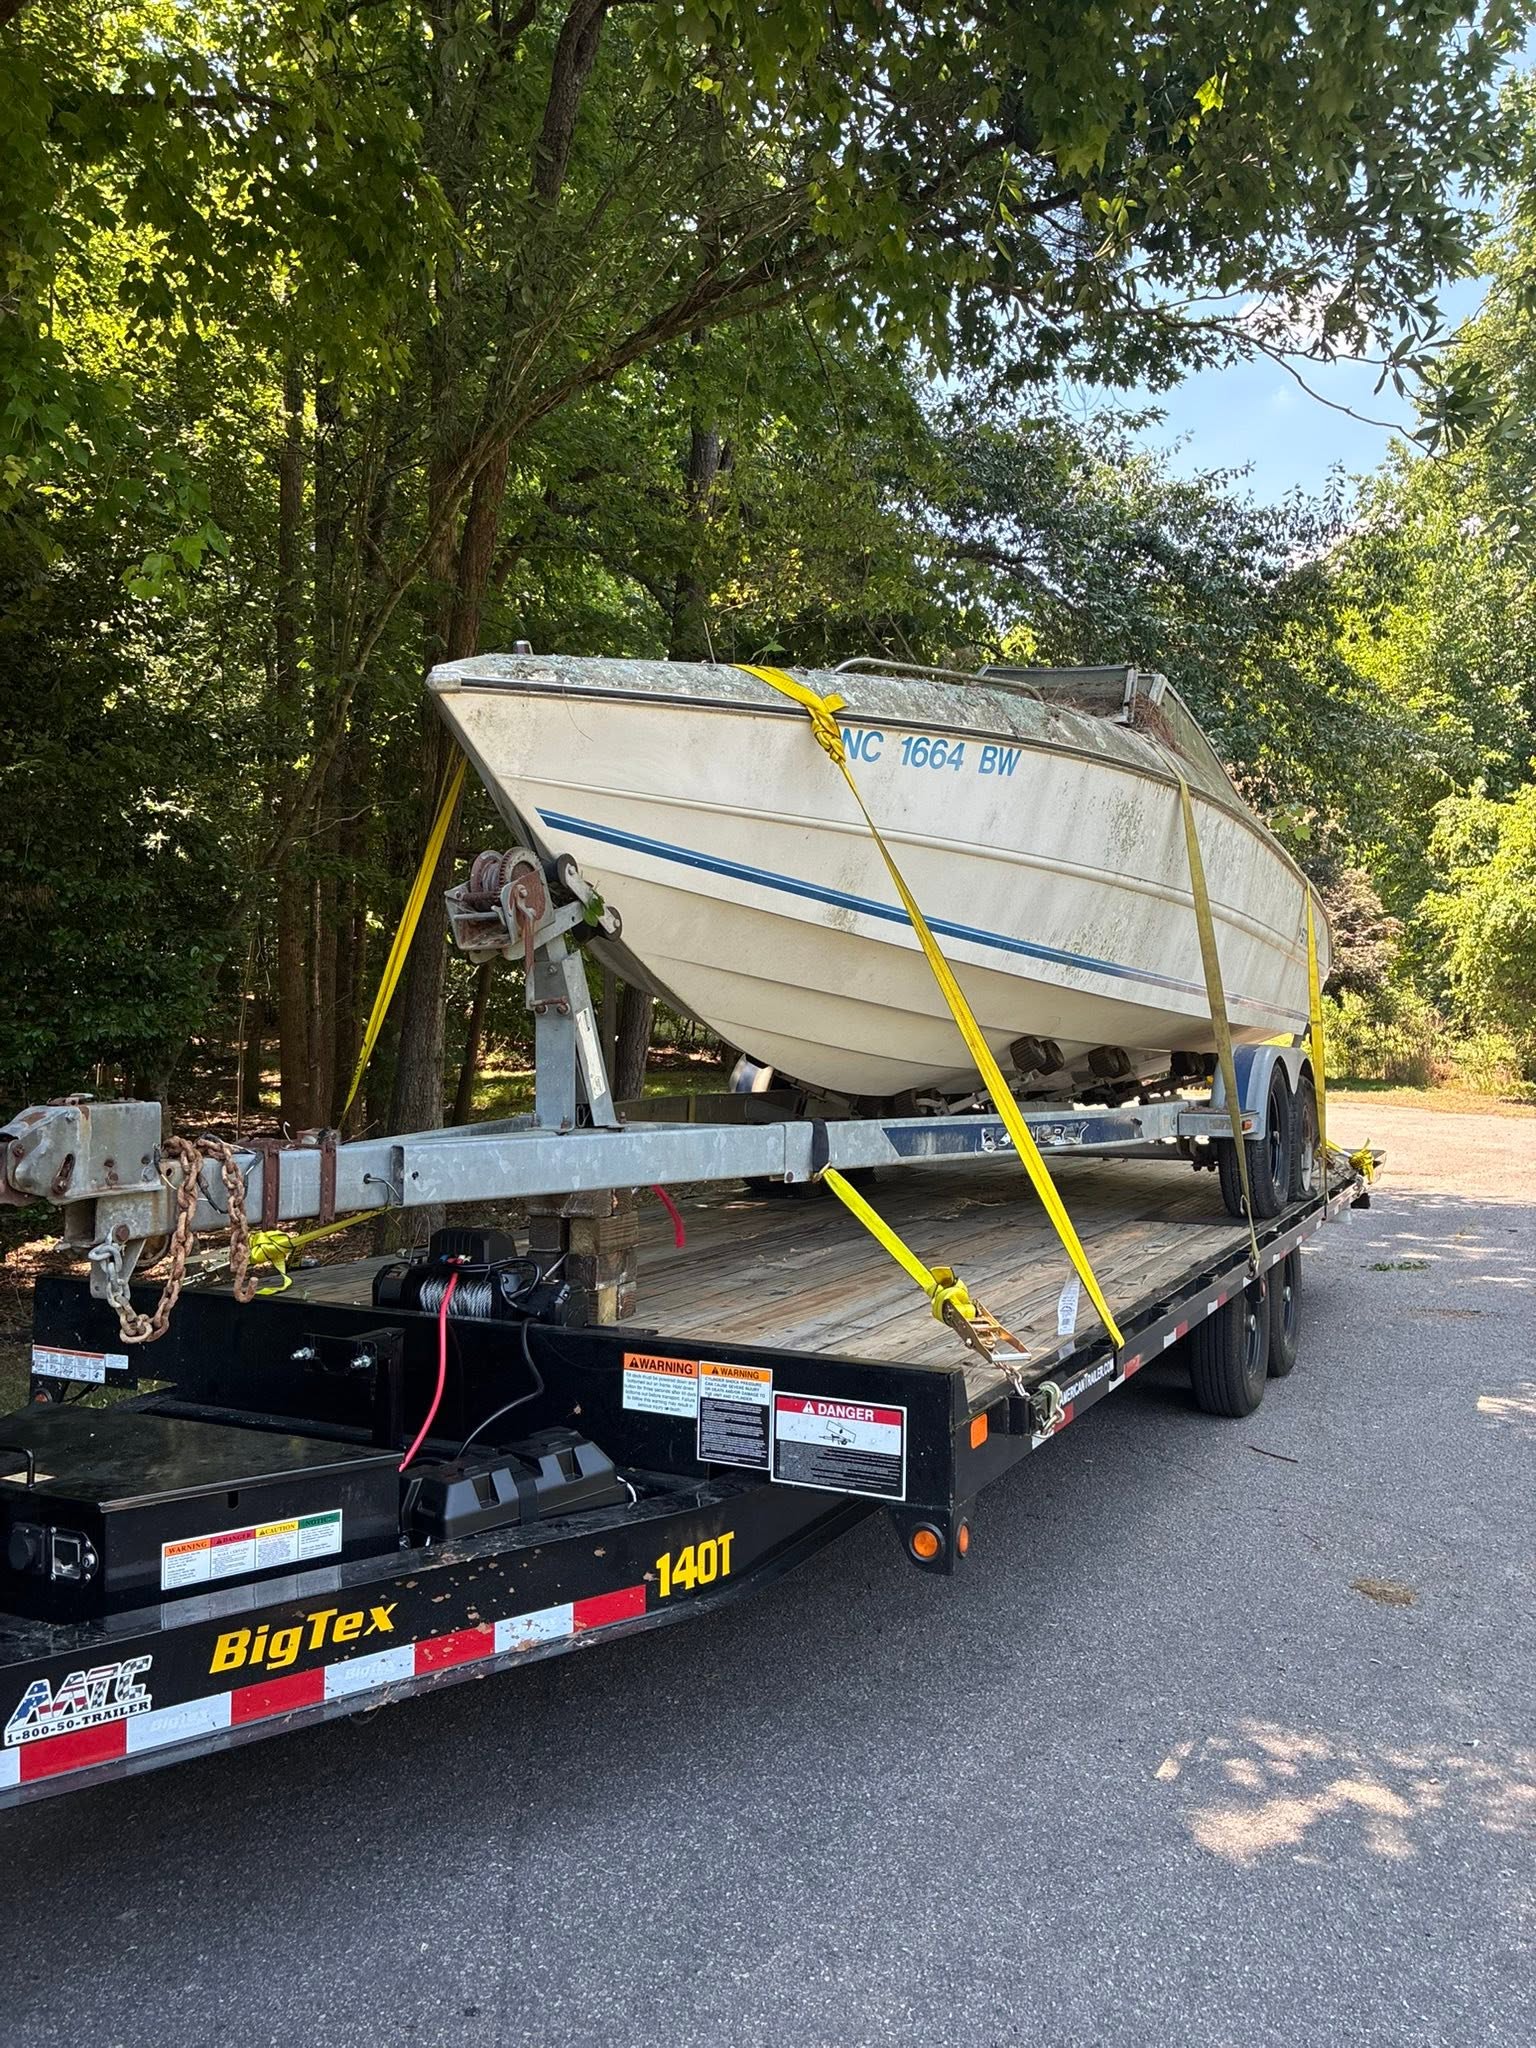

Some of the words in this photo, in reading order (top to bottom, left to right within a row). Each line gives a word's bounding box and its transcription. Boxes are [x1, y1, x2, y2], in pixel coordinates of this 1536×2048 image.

[842, 727, 884, 763] NC
[900, 736, 965, 771] 1664
[978, 745, 1022, 776] BW
[639, 1357, 692, 1375] WARNING
[720, 1367, 758, 1379] WARNING
[817, 1403, 875, 1422] DANGER
[223, 1531, 251, 1543] DANGER
[265, 1522, 294, 1534] CAUTION
[167, 1540, 206, 1554] WARNING
[656, 1531, 735, 1597] 140T
[209, 1602, 398, 1674] BigTex
[7, 1655, 152, 1729] AATC
[7, 1701, 149, 1743] 1-800-50-TRAILER
